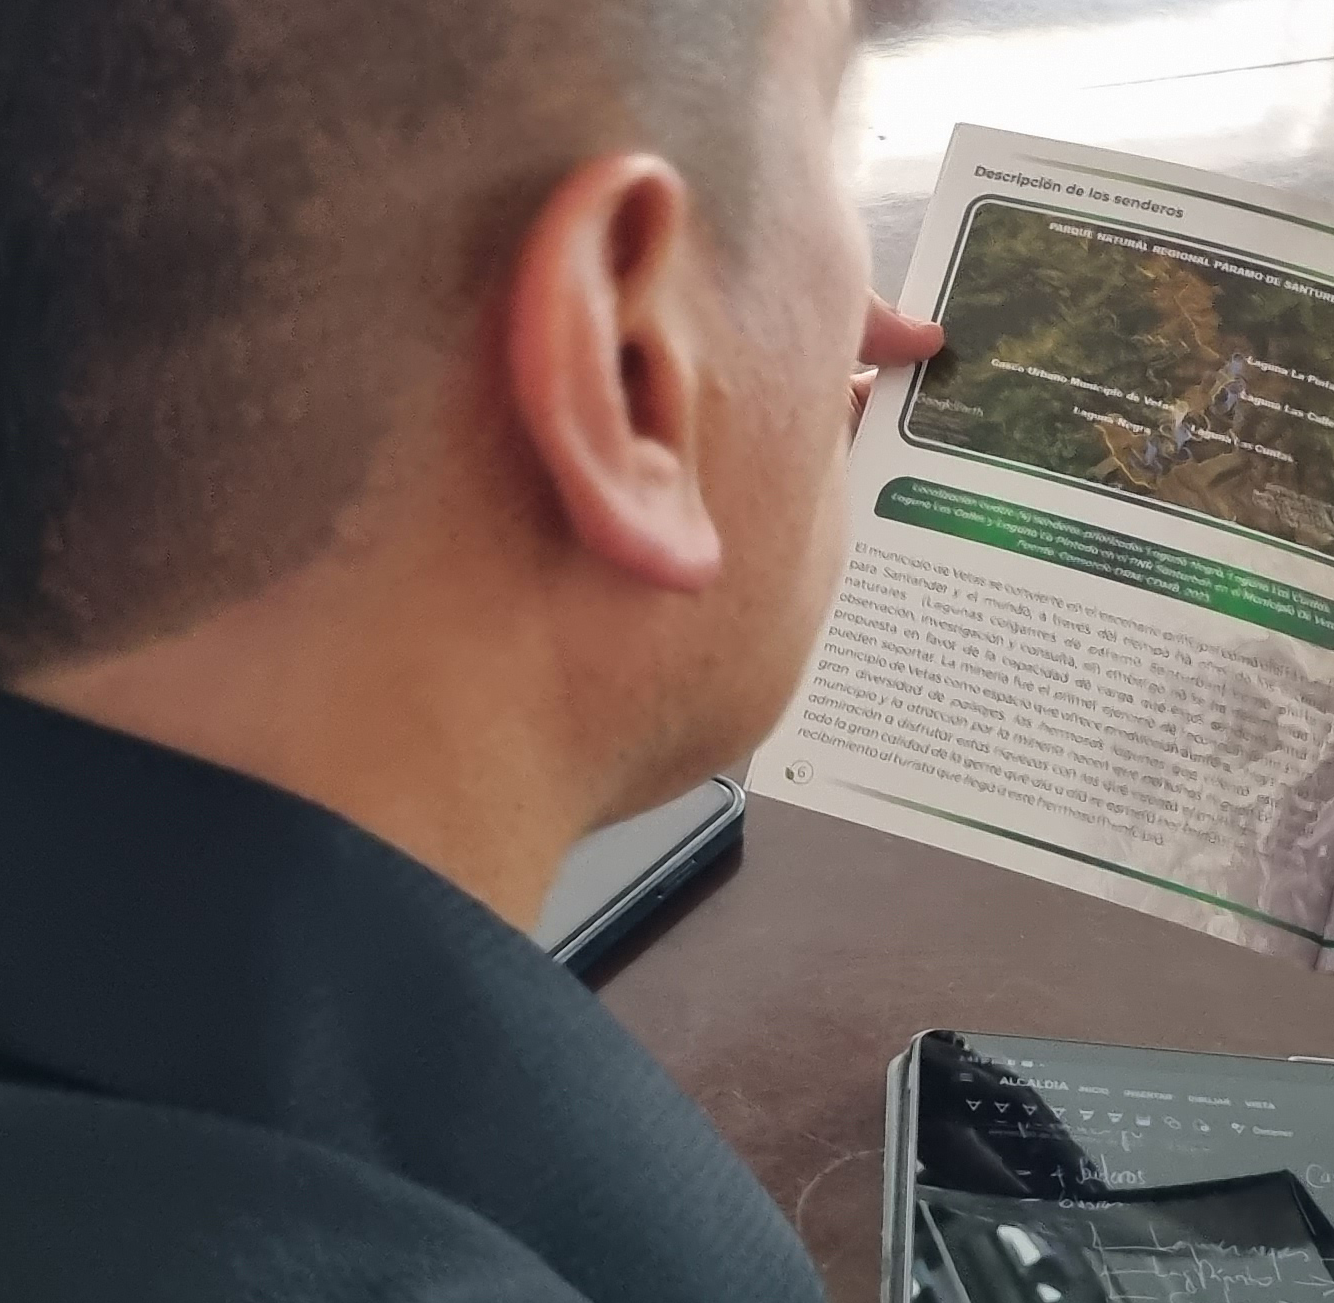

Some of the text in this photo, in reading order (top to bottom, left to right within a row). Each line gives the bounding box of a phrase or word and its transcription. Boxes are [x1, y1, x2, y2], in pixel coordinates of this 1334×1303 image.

[972, 163, 1185, 217] Descripción de los senderos
[1048, 219, 1094, 240] PARQUE
[1096, 229, 1149, 252] NATURAL
[1151, 244, 1211, 266] REGIONAL
[1265, 274, 1281, 285] DE
[990, 357, 1025, 373] Casco
[1026, 366, 1067, 383] Urbano
[1125, 391, 1139, 402] de
[1244, 355, 1288, 376] Laguna
[1290, 369, 1305, 380] La
[1072, 406, 1114, 426] Laguna
[1239, 391, 1281, 411] Laguna
[1283, 404, 1304, 417] Las
[854, 540, 867, 553] El
[867, 544, 932, 574] municipio
[949, 566, 987, 586] Vetas
[1055, 535, 1099, 554] Pintada
[844, 573, 1082, 649] naturales de
[848, 559, 877, 577] para
[882, 566, 948, 594] Santander
[951, 589, 960, 600] y
[965, 590, 979, 603] el
[982, 594, 1034, 620] mundo,
[1096, 627, 1118, 642] del
[822, 640, 887, 670] municipio
[888, 658, 905, 672] de
[906, 664, 943, 683] Vetas
[943, 677, 981, 694] como
[828, 623, 878, 649] pueden
[940, 655, 957, 668] La
[1037, 682, 1051, 695] el
[833, 606, 899, 637] propuesta
[903, 629, 921, 640] en
[924, 632, 957, 650] favor
[961, 643, 980, 657] de
[984, 649, 997, 661] la
[1000, 654, 1070, 685] capacidad
[1074, 675, 1093, 689] de
[1006, 640, 1015, 651] y
[1018, 640, 1079, 669] consulta,
[817, 659, 946, 702] gran diversidad de
[808, 691, 953, 741] admiración a disfrutar
[812, 673, 878, 703] municipio
[878, 695, 888, 706] y
[890, 695, 904, 708] la
[970, 722, 993, 737] por
[996, 726, 1011, 739] la
[797, 725, 879, 757] recibimiento
[879, 748, 893, 761] al
[846, 724, 879, 742] gran
[880, 730, 930, 753] calidad
[930, 744, 948, 758] de
[797, 765, 806, 778] 6
[998, 1075, 1069, 1091] ALCALDIA
[1244, 1100, 1277, 1111] VISTA
